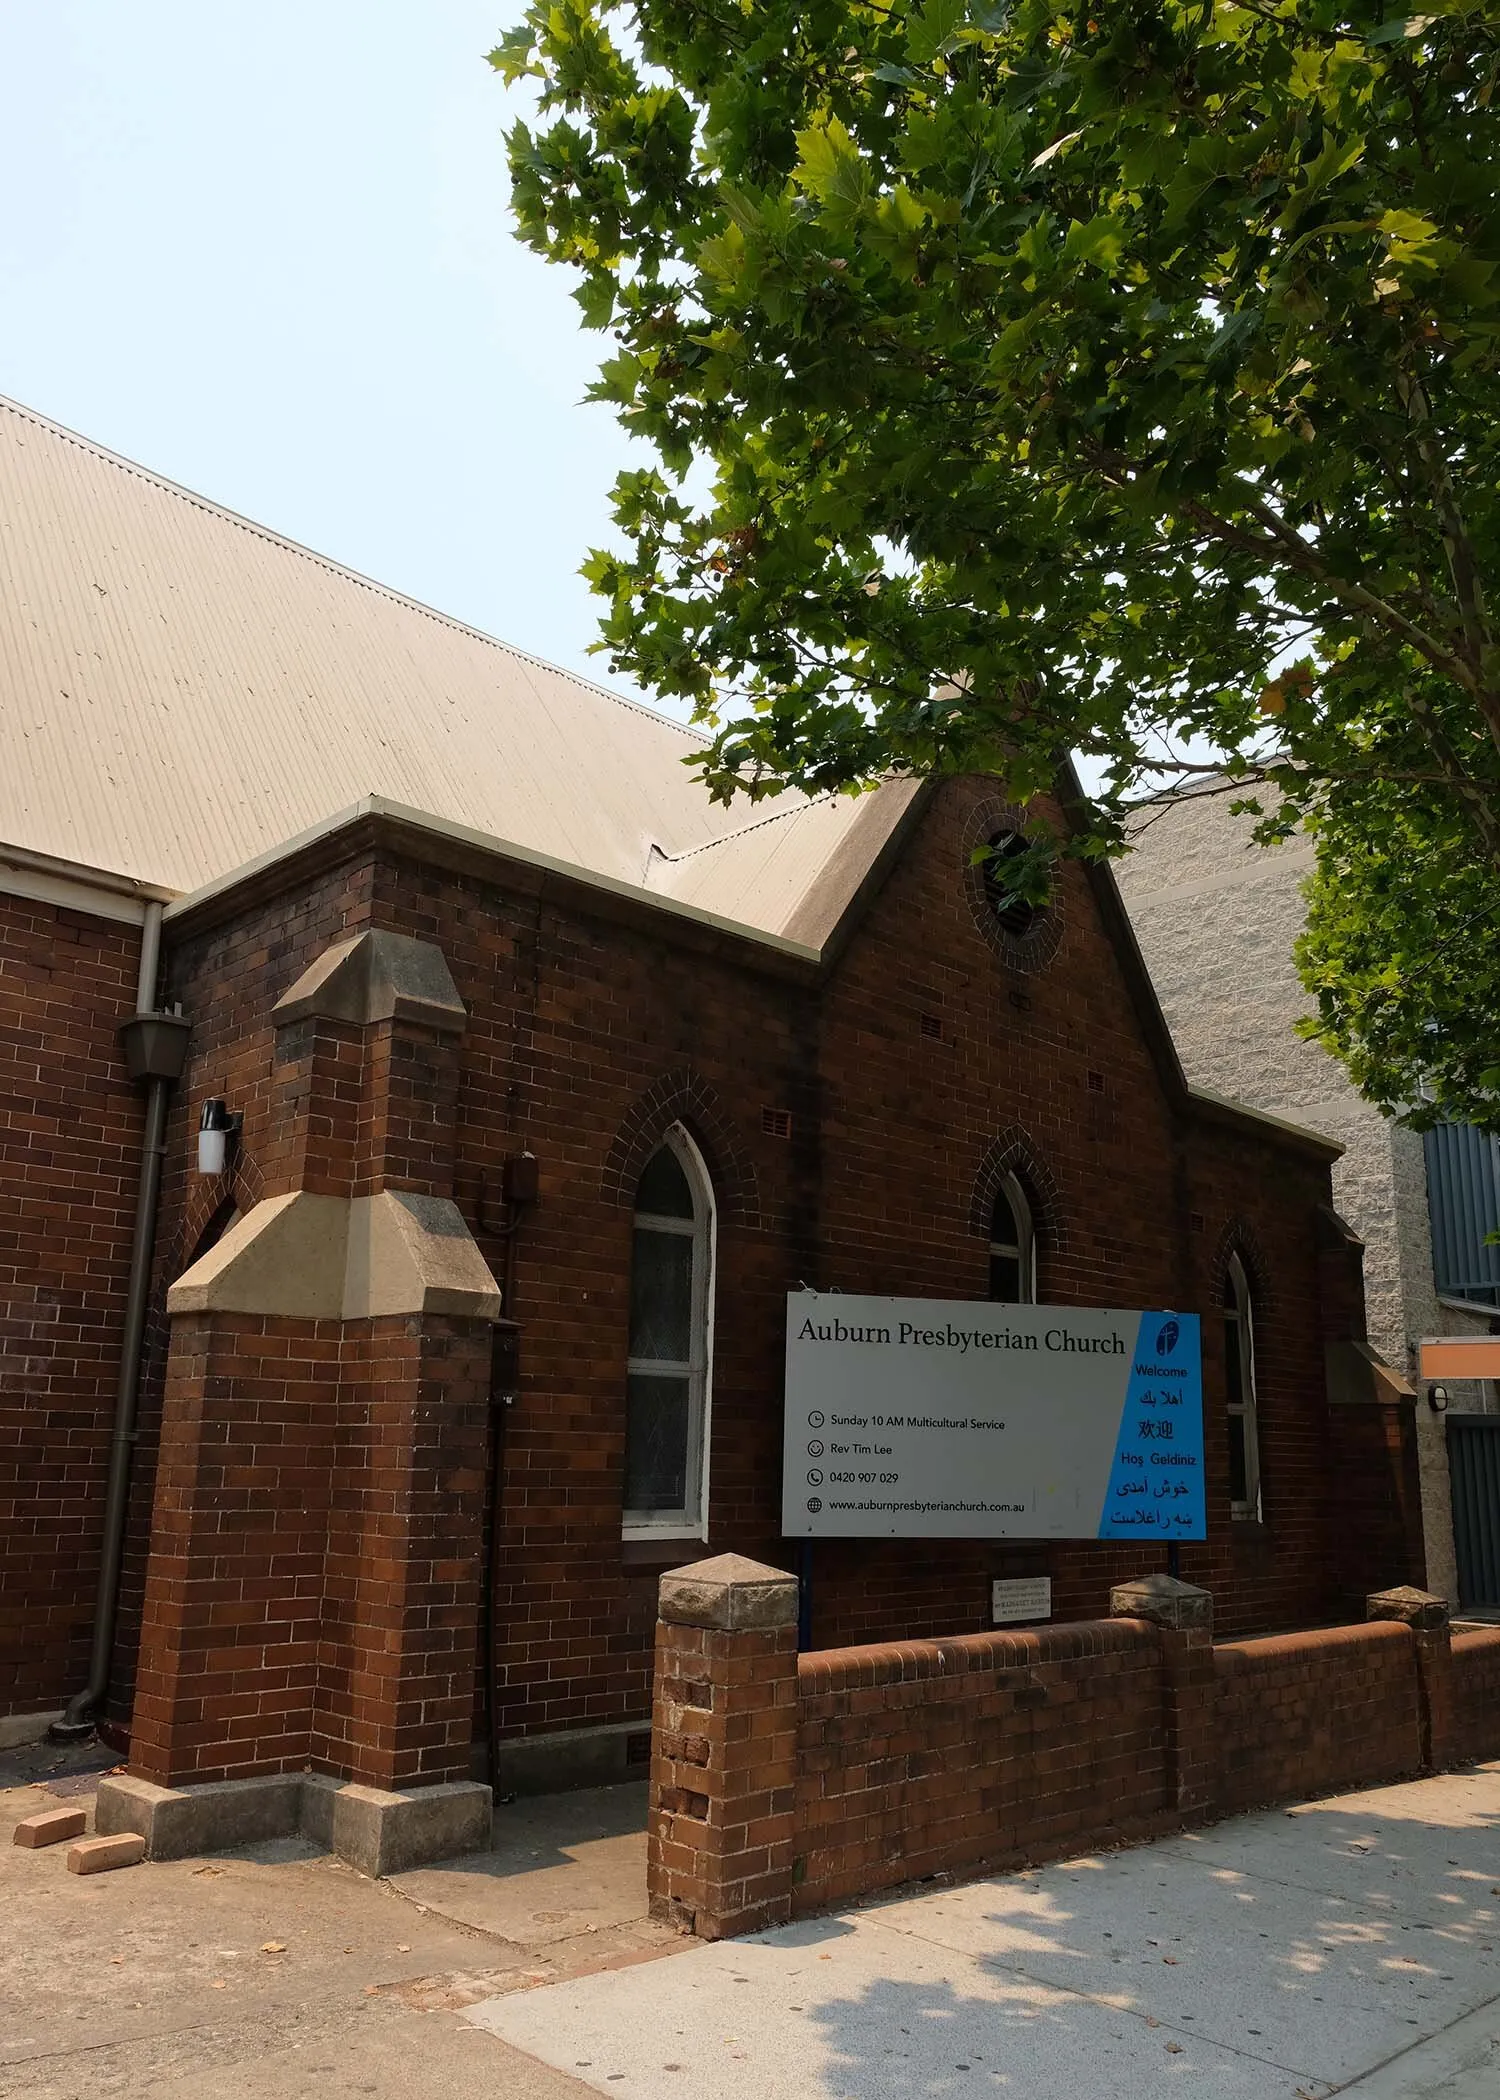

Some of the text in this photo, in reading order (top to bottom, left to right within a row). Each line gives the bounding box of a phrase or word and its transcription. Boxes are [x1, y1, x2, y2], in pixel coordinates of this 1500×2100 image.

[798, 1317, 1126, 1354] Auburn Presbyterian Church
[1136, 1364, 1188, 1377] Welcome
[831, 1414, 1005, 1430] Sunday 10 AM Multicultural Service
[1138, 1420, 1174, 1440] 欢迎
[831, 1443, 893, 1455] Rev Tim Lee
[1121, 1452, 1197, 1468] Hoş Geldiniz
[829, 1472, 899, 1484] 0420 907 029
[1153, 1480, 1190, 1498] خوش
[829, 1499, 1025, 1514] www.auburnpresbyterianchurch.com.au
